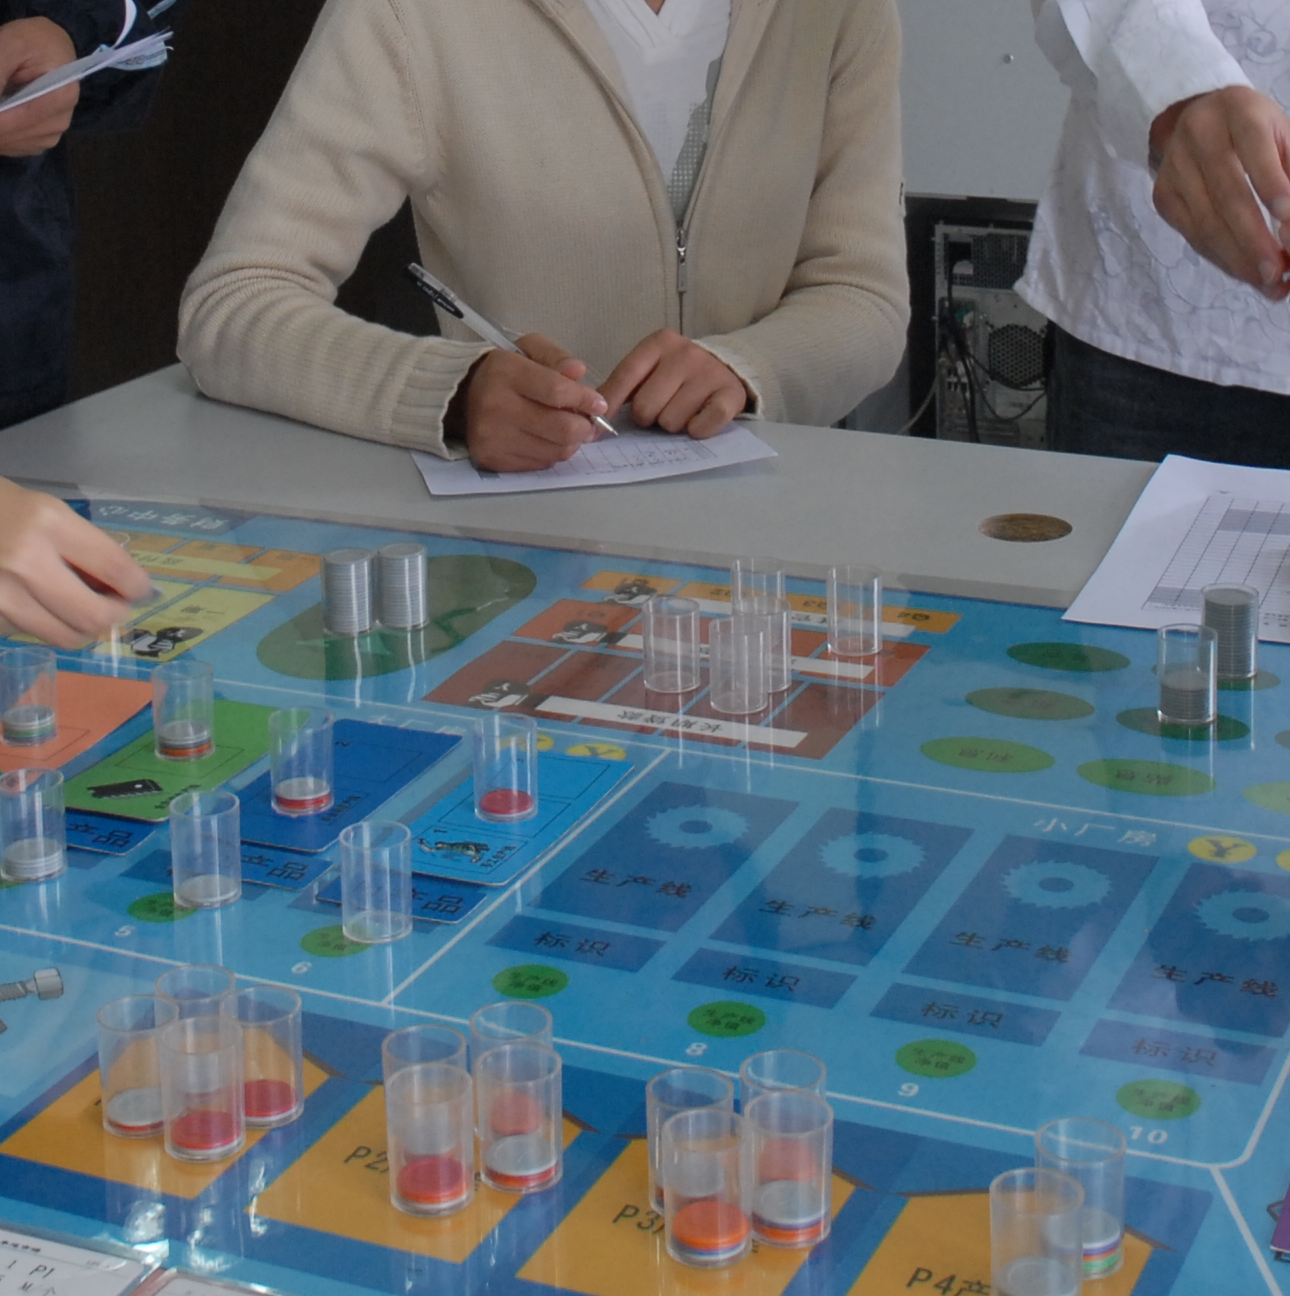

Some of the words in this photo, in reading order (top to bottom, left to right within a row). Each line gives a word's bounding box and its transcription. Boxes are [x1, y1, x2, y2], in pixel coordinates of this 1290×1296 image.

[99, 505, 229, 530] 财务中心
[1033, 817, 1157, 847] 小厂房
[579, 867, 692, 901] 生产线
[759, 899, 877, 931] 生产线
[534, 931, 611, 957] 标识
[949, 931, 1071, 964] 生产线
[291, 961, 313, 974] 6
[722, 965, 801, 992] 标识
[1150, 964, 1279, 999] 生产线
[921, 1001, 1004, 1029] 标识
[686, 1041, 706, 1057] 8
[1131, 1037, 1218, 1067] 标识
[897, 1081, 920, 1098] 9
[1129, 1125, 1169, 1145] 10
